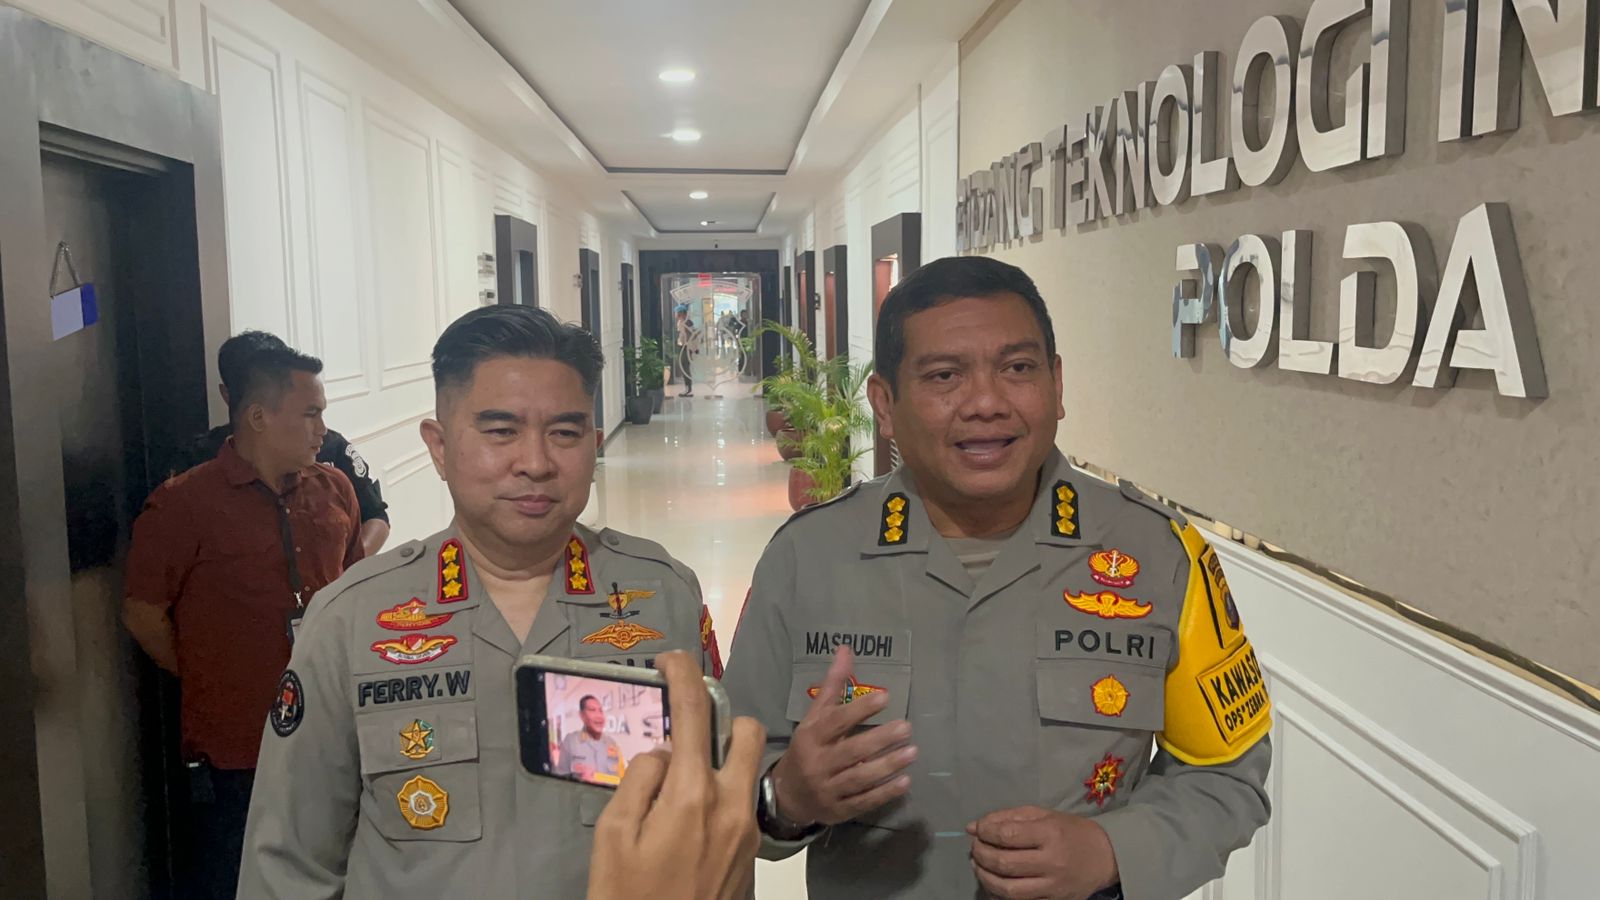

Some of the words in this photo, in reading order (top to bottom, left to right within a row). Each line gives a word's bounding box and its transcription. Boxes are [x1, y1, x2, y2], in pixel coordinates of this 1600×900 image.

[1043, 0, 1403, 230] TEKNOLOGI
[1438, 0, 1600, 142] IN
[1172, 203, 1536, 398] POLDA
[358, 670, 471, 707] FERRY.W
[1055, 629, 1155, 659] POLRI
